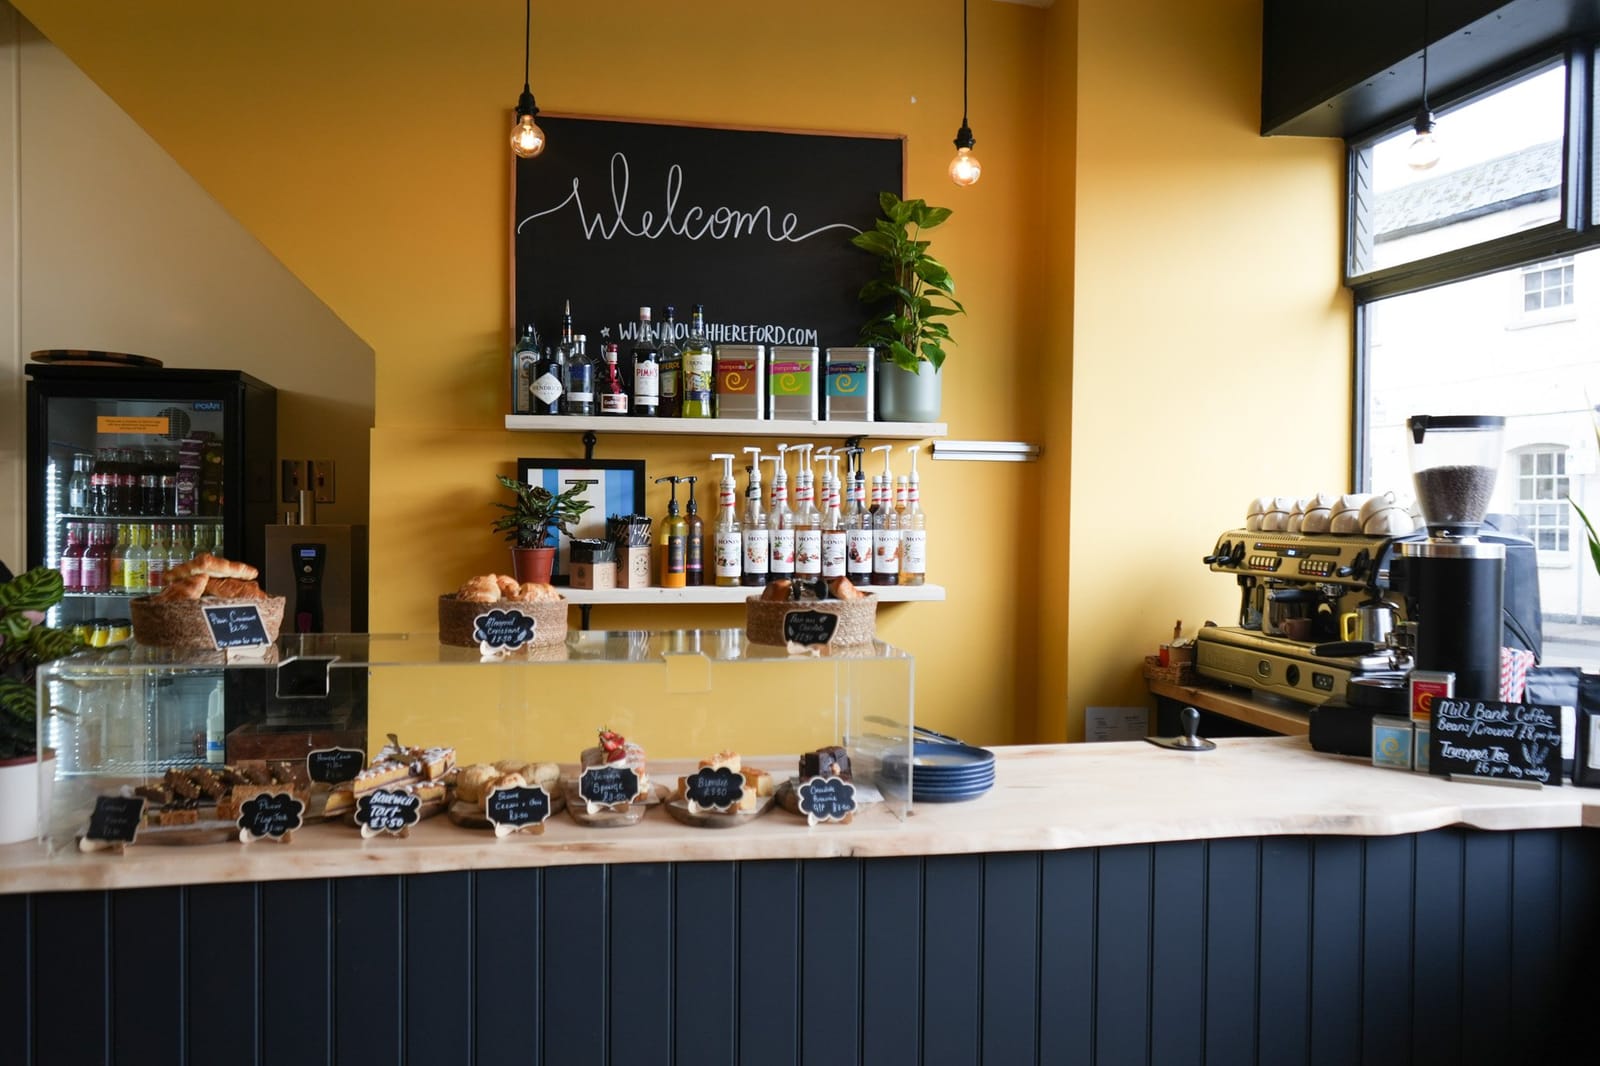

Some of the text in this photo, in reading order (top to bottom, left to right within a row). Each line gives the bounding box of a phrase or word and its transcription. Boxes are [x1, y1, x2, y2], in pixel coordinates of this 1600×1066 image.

[1438, 701, 1554, 725] Mill Bank Coffee
